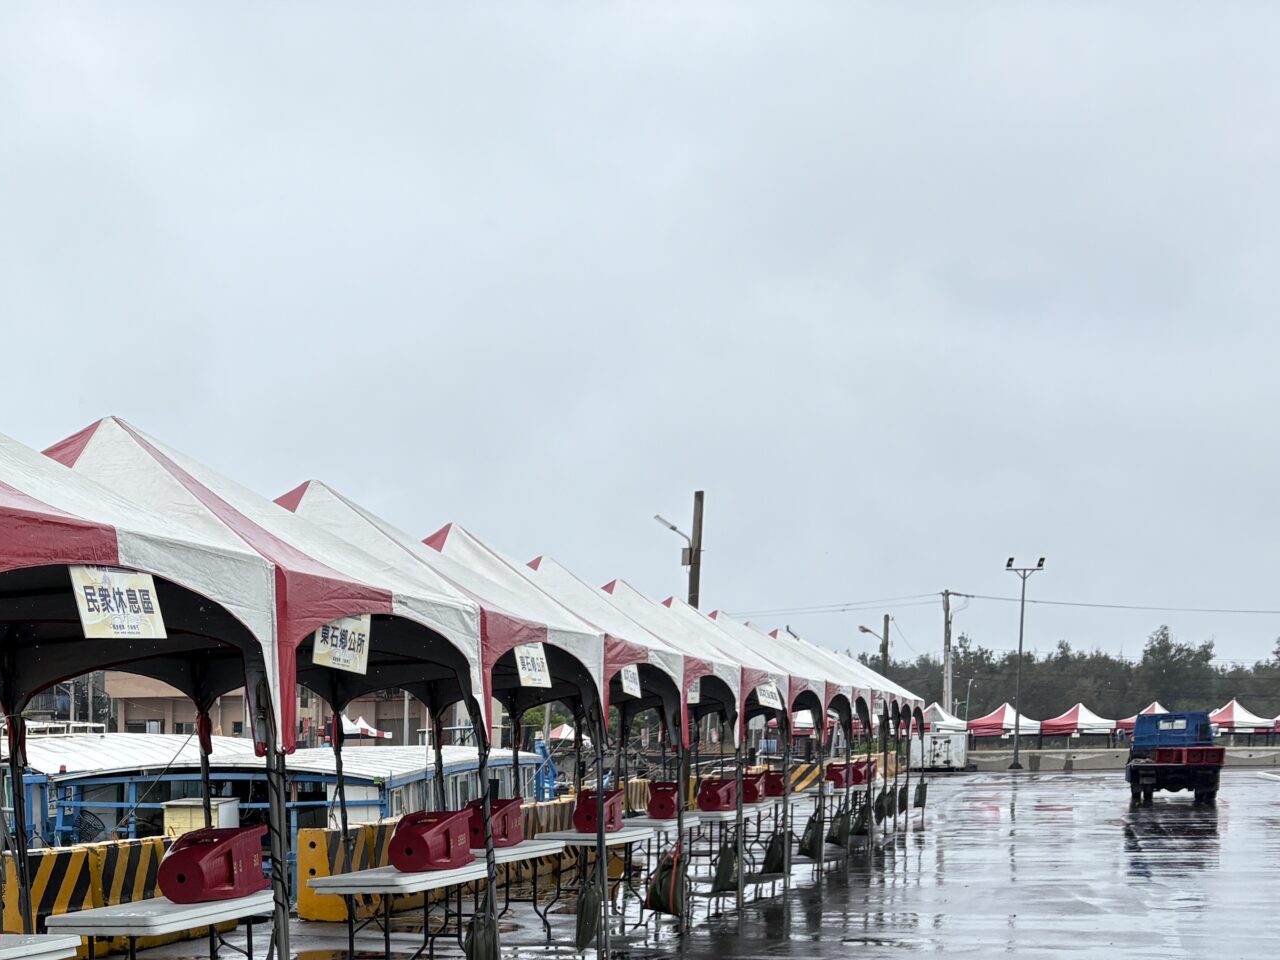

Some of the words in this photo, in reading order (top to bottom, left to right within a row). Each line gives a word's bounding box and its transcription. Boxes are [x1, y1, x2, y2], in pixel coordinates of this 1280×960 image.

[320, 624, 366, 655] 東石鄉公所
